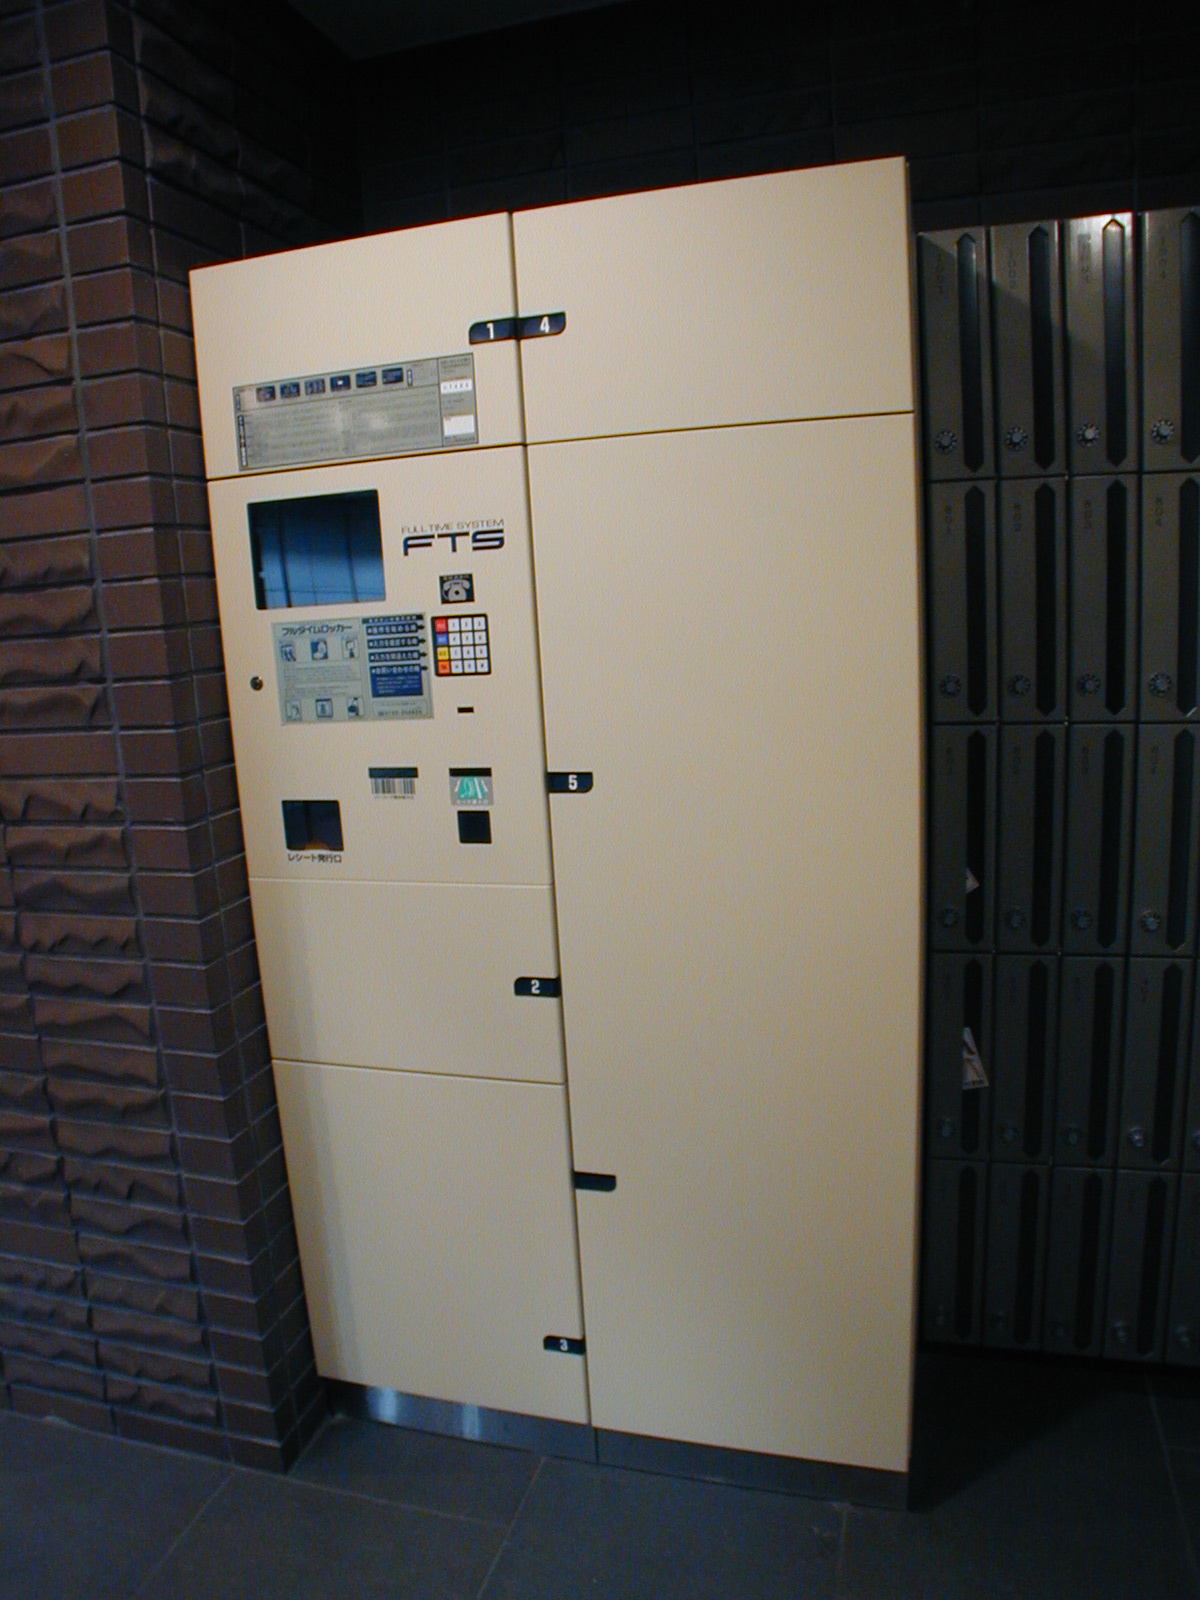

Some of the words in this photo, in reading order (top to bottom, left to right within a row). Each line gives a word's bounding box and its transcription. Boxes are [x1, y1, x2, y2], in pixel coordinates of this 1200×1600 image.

[486, 322, 495, 340] 1
[539, 315, 551, 334] 4
[456, 517, 505, 530] SYSTEM
[402, 528, 505, 557] FTS
[281, 623, 353, 637] フルタイムロッカー
[568, 774, 579, 790] 5
[530, 979, 541, 994] 2
[559, 1338, 569, 1351] 3
